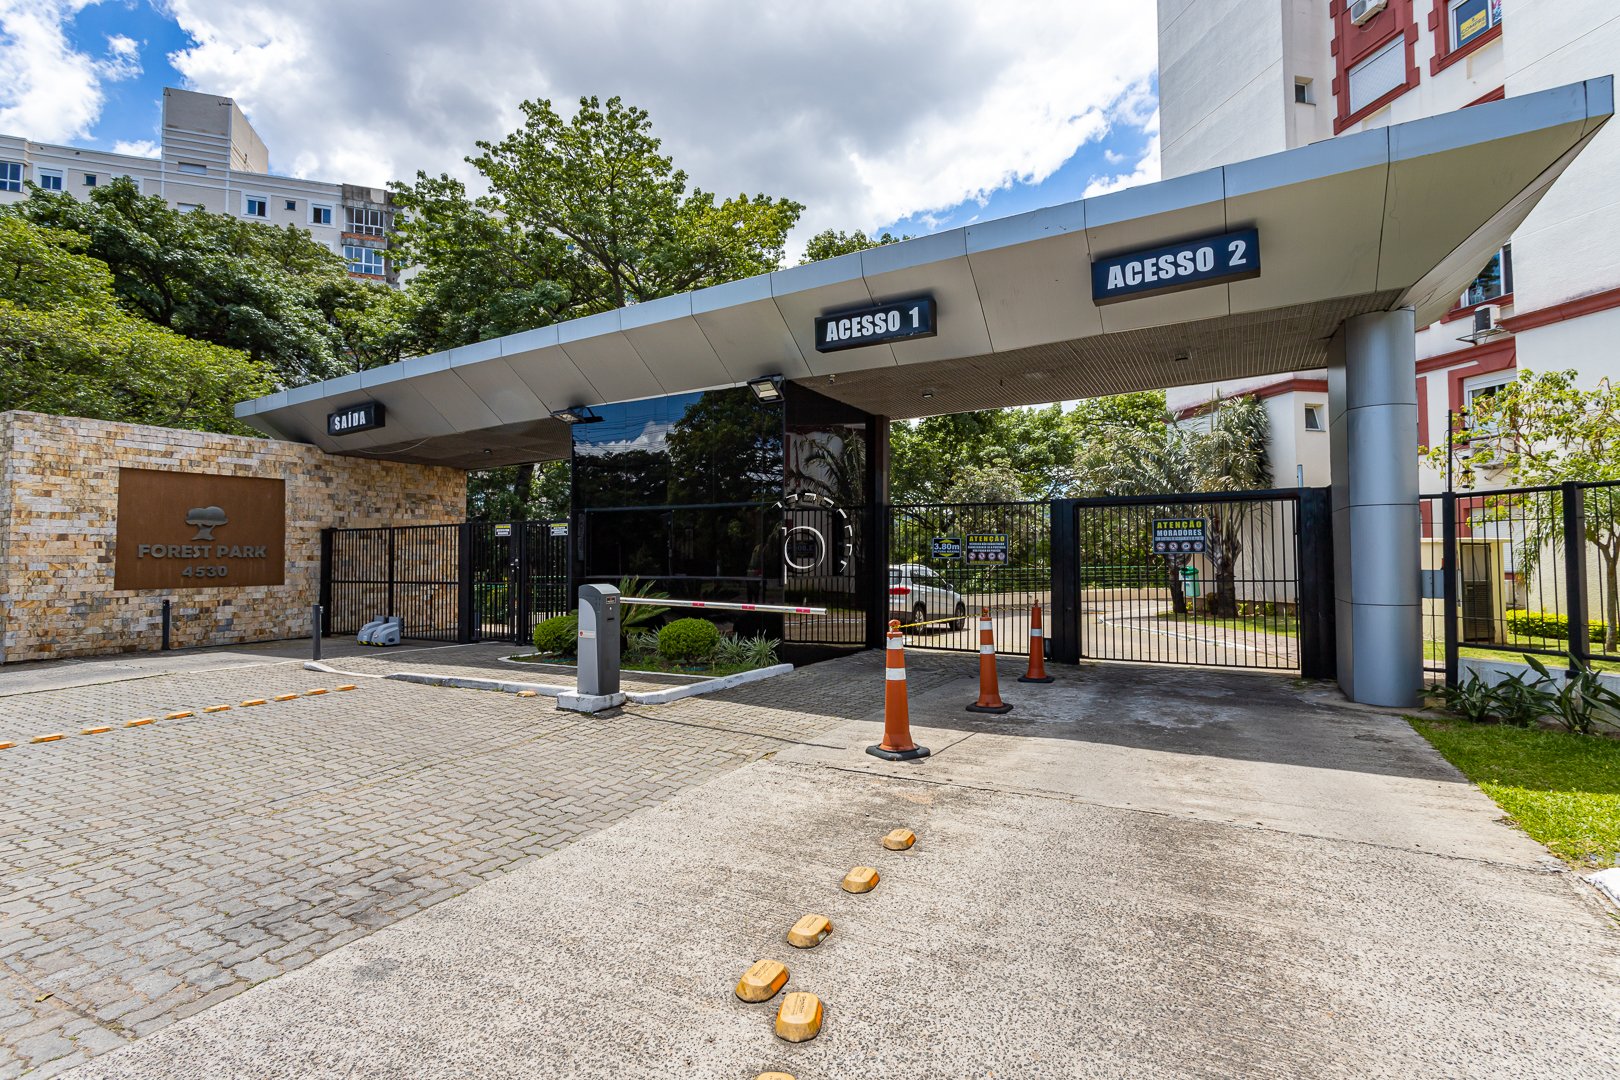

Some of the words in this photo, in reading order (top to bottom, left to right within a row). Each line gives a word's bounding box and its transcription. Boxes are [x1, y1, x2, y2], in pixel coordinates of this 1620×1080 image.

[1107, 247, 1214, 289] ACESSO
[1228, 240, 1246, 266] 2
[826, 310, 900, 341] ACESSO
[909, 306, 919, 328] 1
[334, 411, 366, 430] SAÍDA
[1157, 520, 1202, 529] ATENÇÃO
[138, 544, 212, 558] FOREST
[216, 545, 267, 558] PARK
[181, 565, 228, 577] 4530
